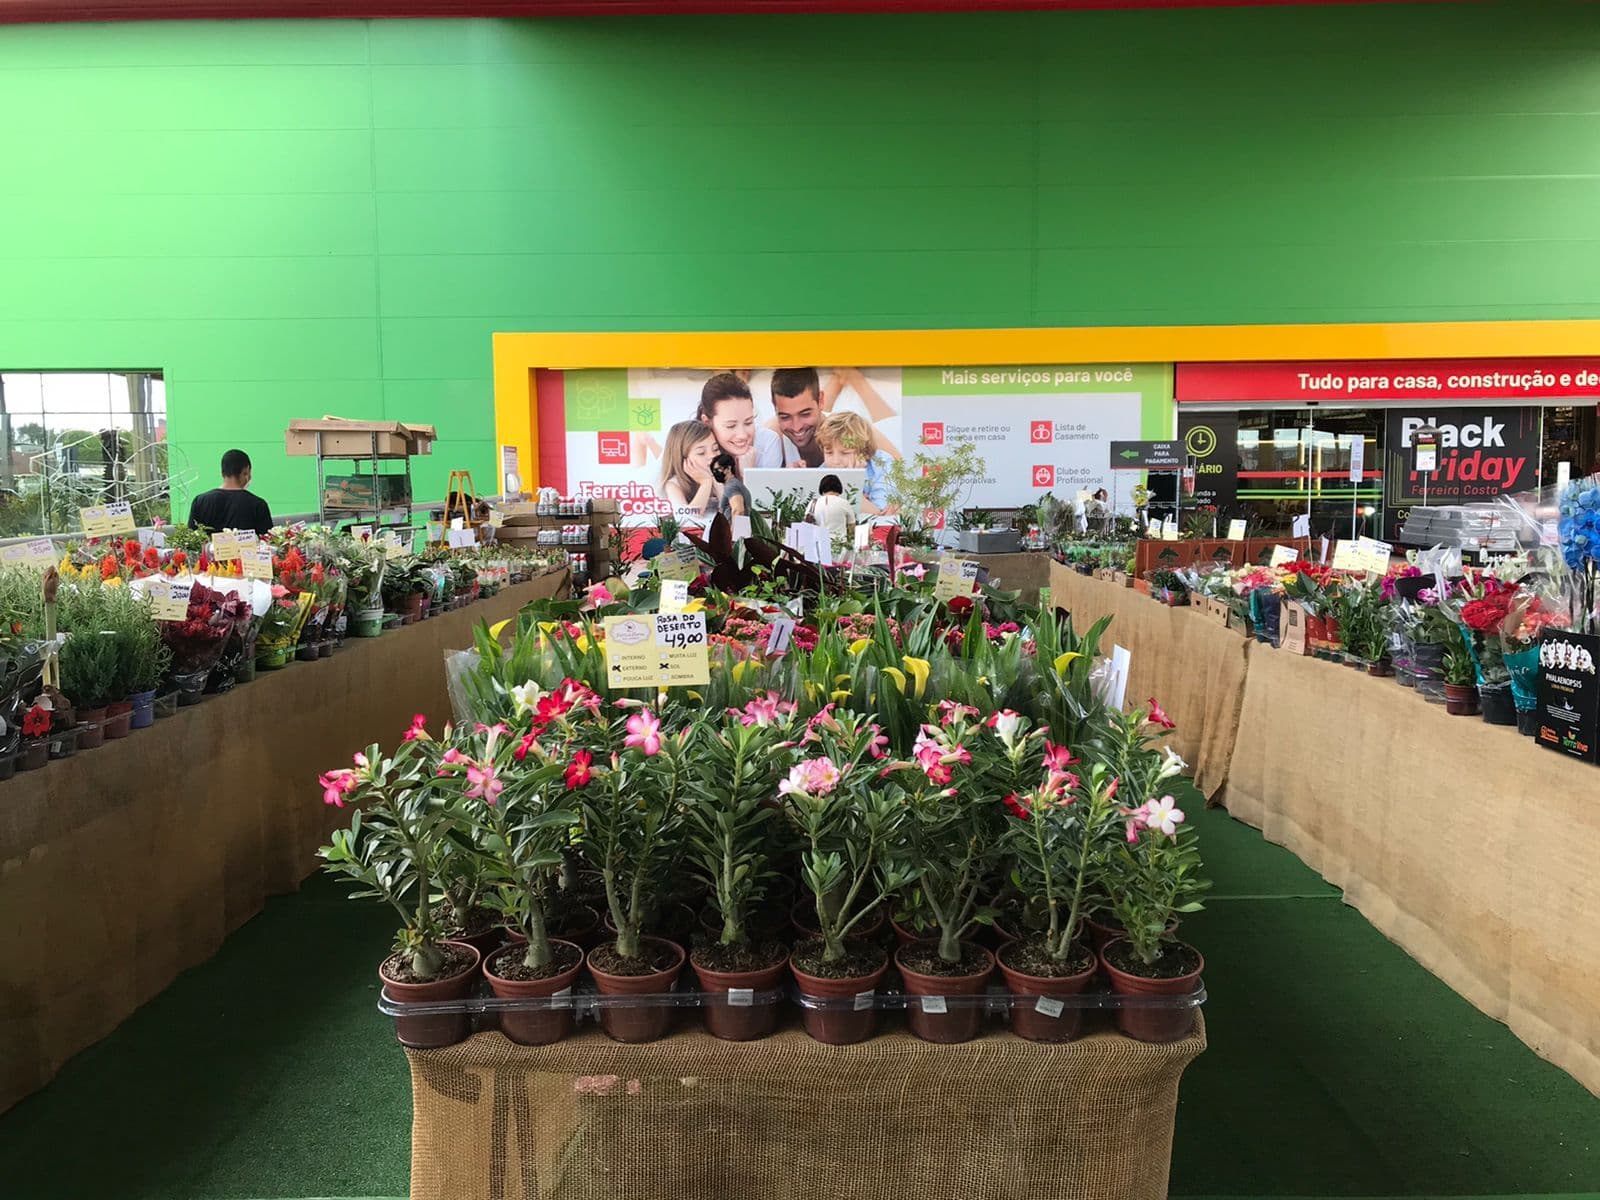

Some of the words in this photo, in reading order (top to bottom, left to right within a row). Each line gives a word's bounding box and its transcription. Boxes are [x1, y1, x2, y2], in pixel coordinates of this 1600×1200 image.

[941, 370, 977, 385] Mais
[981, 368, 1050, 387] serviços
[1054, 370, 1091, 386] para
[1095, 367, 1134, 383] você
[1298, 373, 1343, 389] Tudo
[1348, 375, 1389, 393] para
[1393, 375, 1442, 391] casa,
[1447, 370, 1556, 390] construção
[1560, 374, 1571, 386] e
[1575, 370, 1600, 386] de
[946, 424, 970, 434] Clique
[978, 424, 999, 433] retire
[1001, 425, 1011, 433] ou
[1055, 432, 1099, 441] Casamento
[1057, 467, 1079, 475] Clube
[1080, 467, 1091, 475] do
[1057, 476, 1104, 484] Profissional
[580, 481, 654, 499] Ferreira
[1411, 484, 1460, 495] Ferreira
[1463, 484, 1499, 495] Costa
[619, 498, 673, 515] Costa
[675, 506, 701, 515] .com
[656, 614, 678, 623] ROSA
[657, 622, 701, 633] DESERTO
[665, 633, 703, 649] 49,00
[1545, 672, 1583, 689] PHALAENOPSIS
